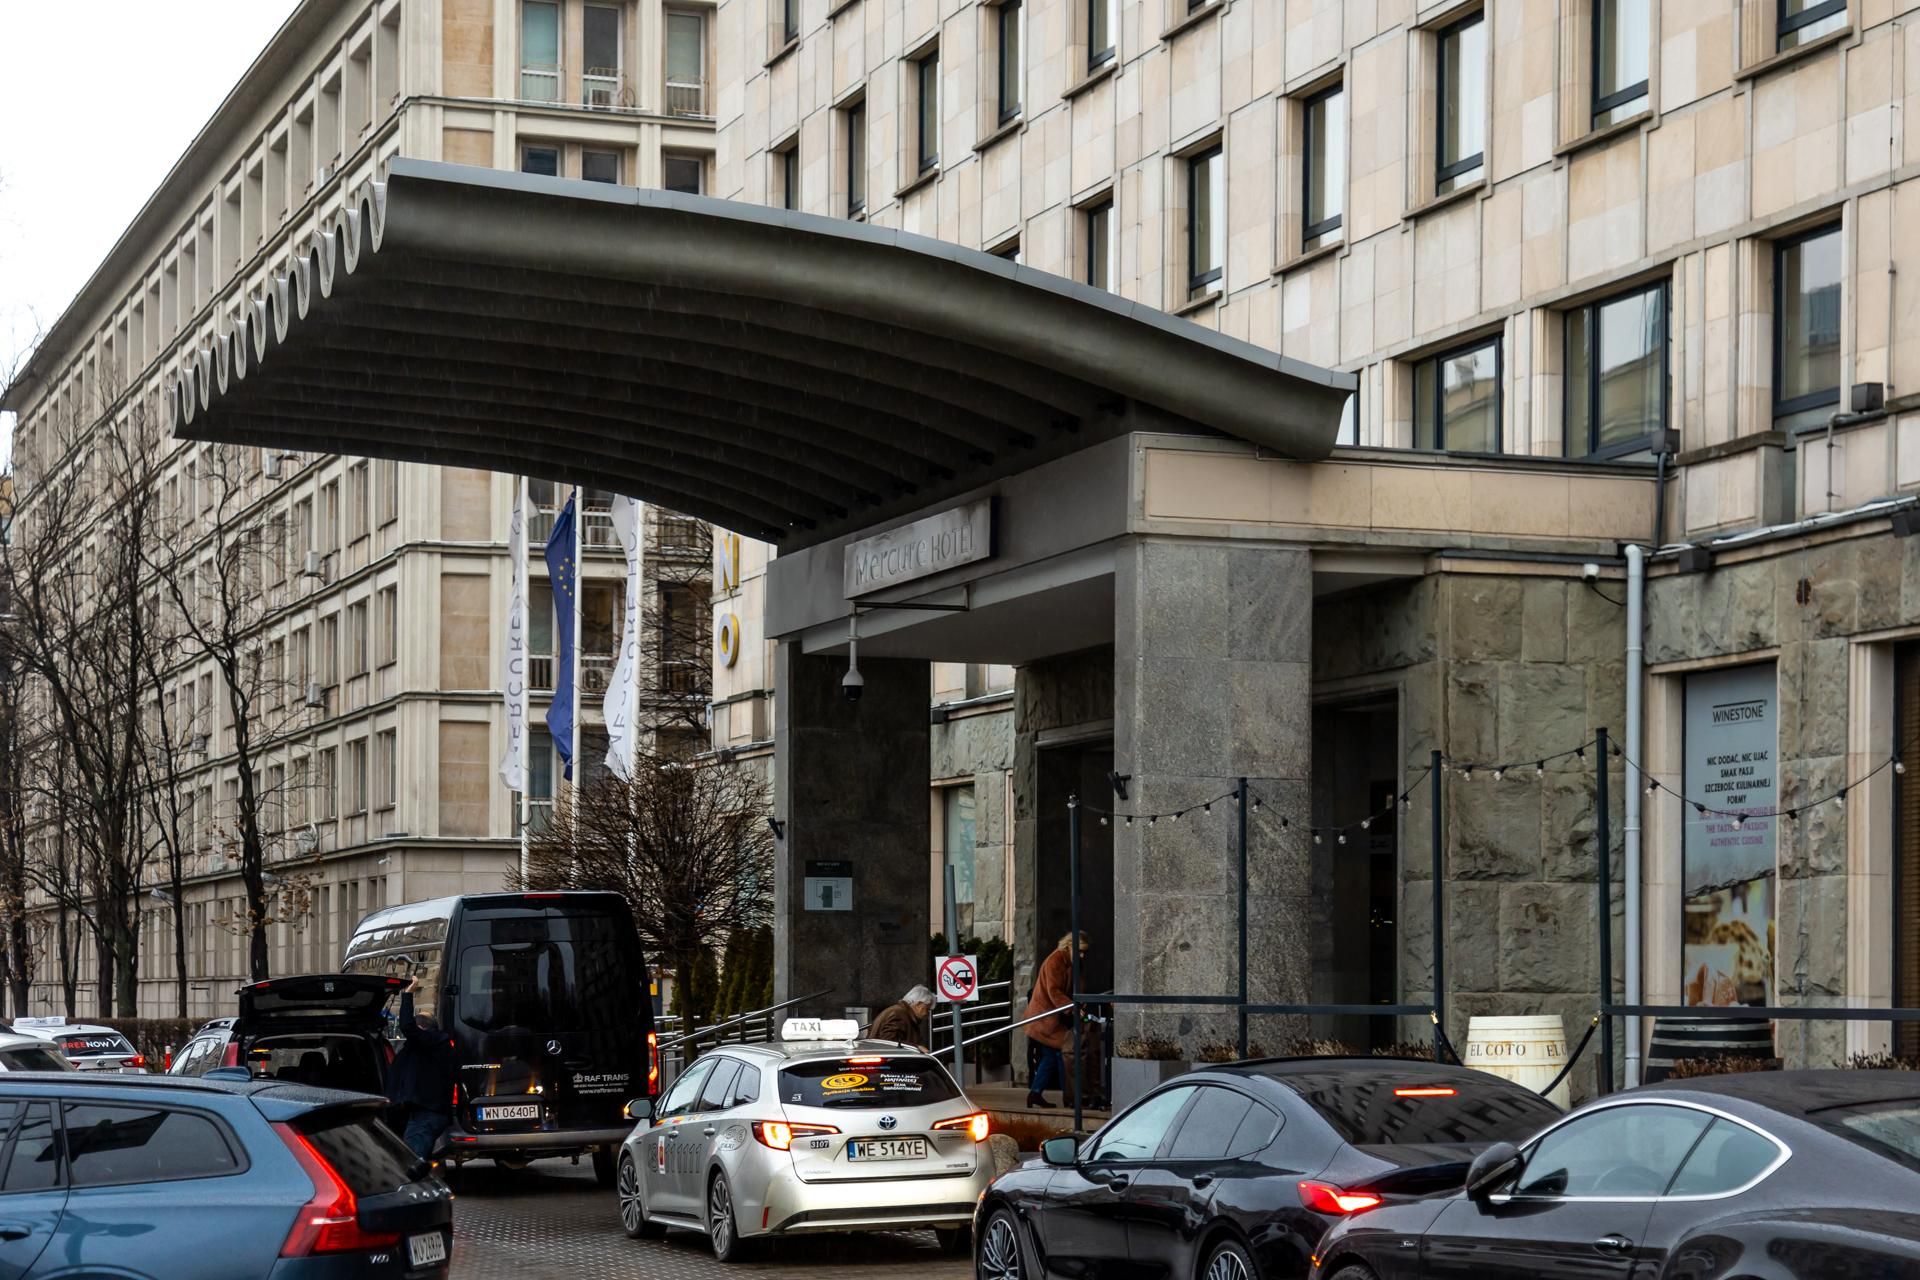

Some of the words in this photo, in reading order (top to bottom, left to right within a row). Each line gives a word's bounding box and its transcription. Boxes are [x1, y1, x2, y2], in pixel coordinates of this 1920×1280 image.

[931, 523, 976, 562] HOTEL
[1712, 705, 1763, 723] WINESTONE
[1707, 756, 1717, 766] NIC
[1742, 753, 1752, 763] NIC
[1720, 767, 1737, 778] SMAK
[1738, 766, 1754, 776] PASJI
[1736, 778, 1771, 790] KULINARNEJ
[1727, 795, 1747, 805] FORMY
[791, 1022, 821, 1031] TAXI
[1470, 1043, 1482, 1057] EL
[1485, 1043, 1526, 1057] COTO
[602, 1073, 629, 1081] TRANS
[485, 1108, 499, 1119] WN
[502, 1106, 535, 1118] 0640P
[811, 1140, 829, 1149] 3107
[857, 1143, 875, 1157] WE
[881, 1141, 923, 1156] 514YE
